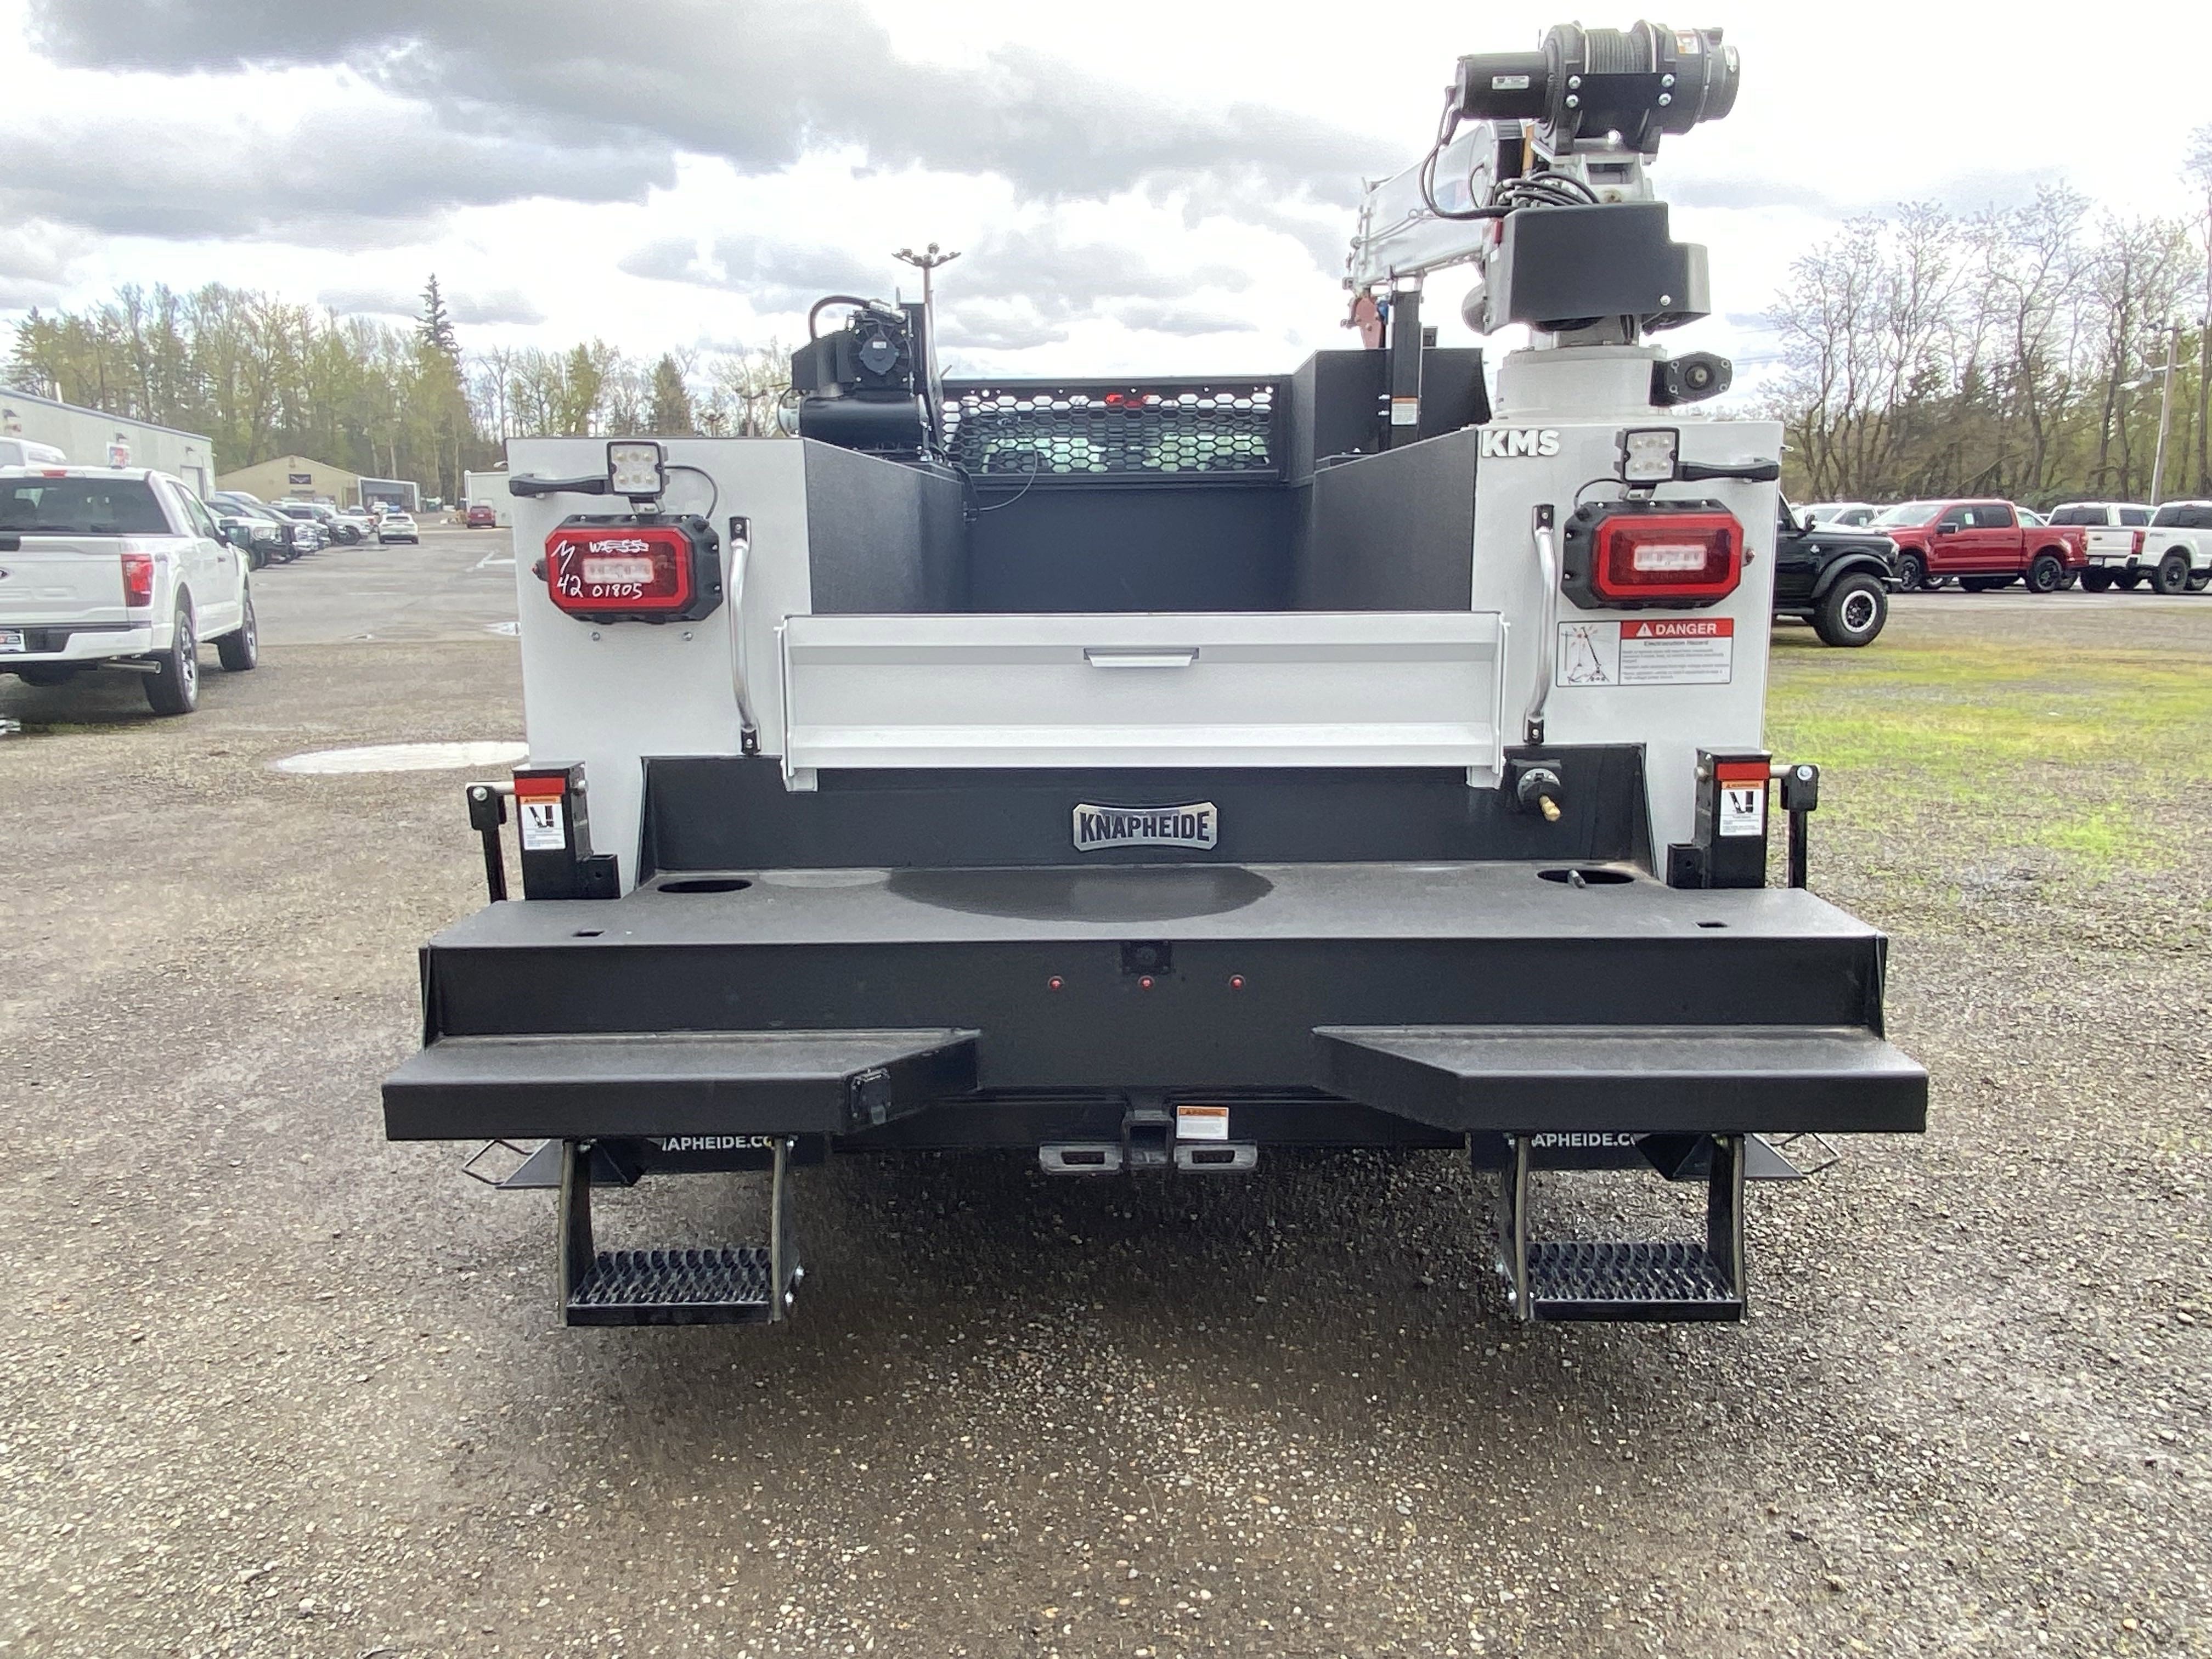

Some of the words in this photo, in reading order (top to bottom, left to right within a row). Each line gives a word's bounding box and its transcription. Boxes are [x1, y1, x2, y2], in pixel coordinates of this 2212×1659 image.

[1482, 430, 1560, 457] KMS
[556, 574, 584, 598] 42
[592, 583, 642, 600] 01805
[1655, 623, 1717, 635] DANGER
[1079, 810, 1210, 843] KNAPHEIDE
